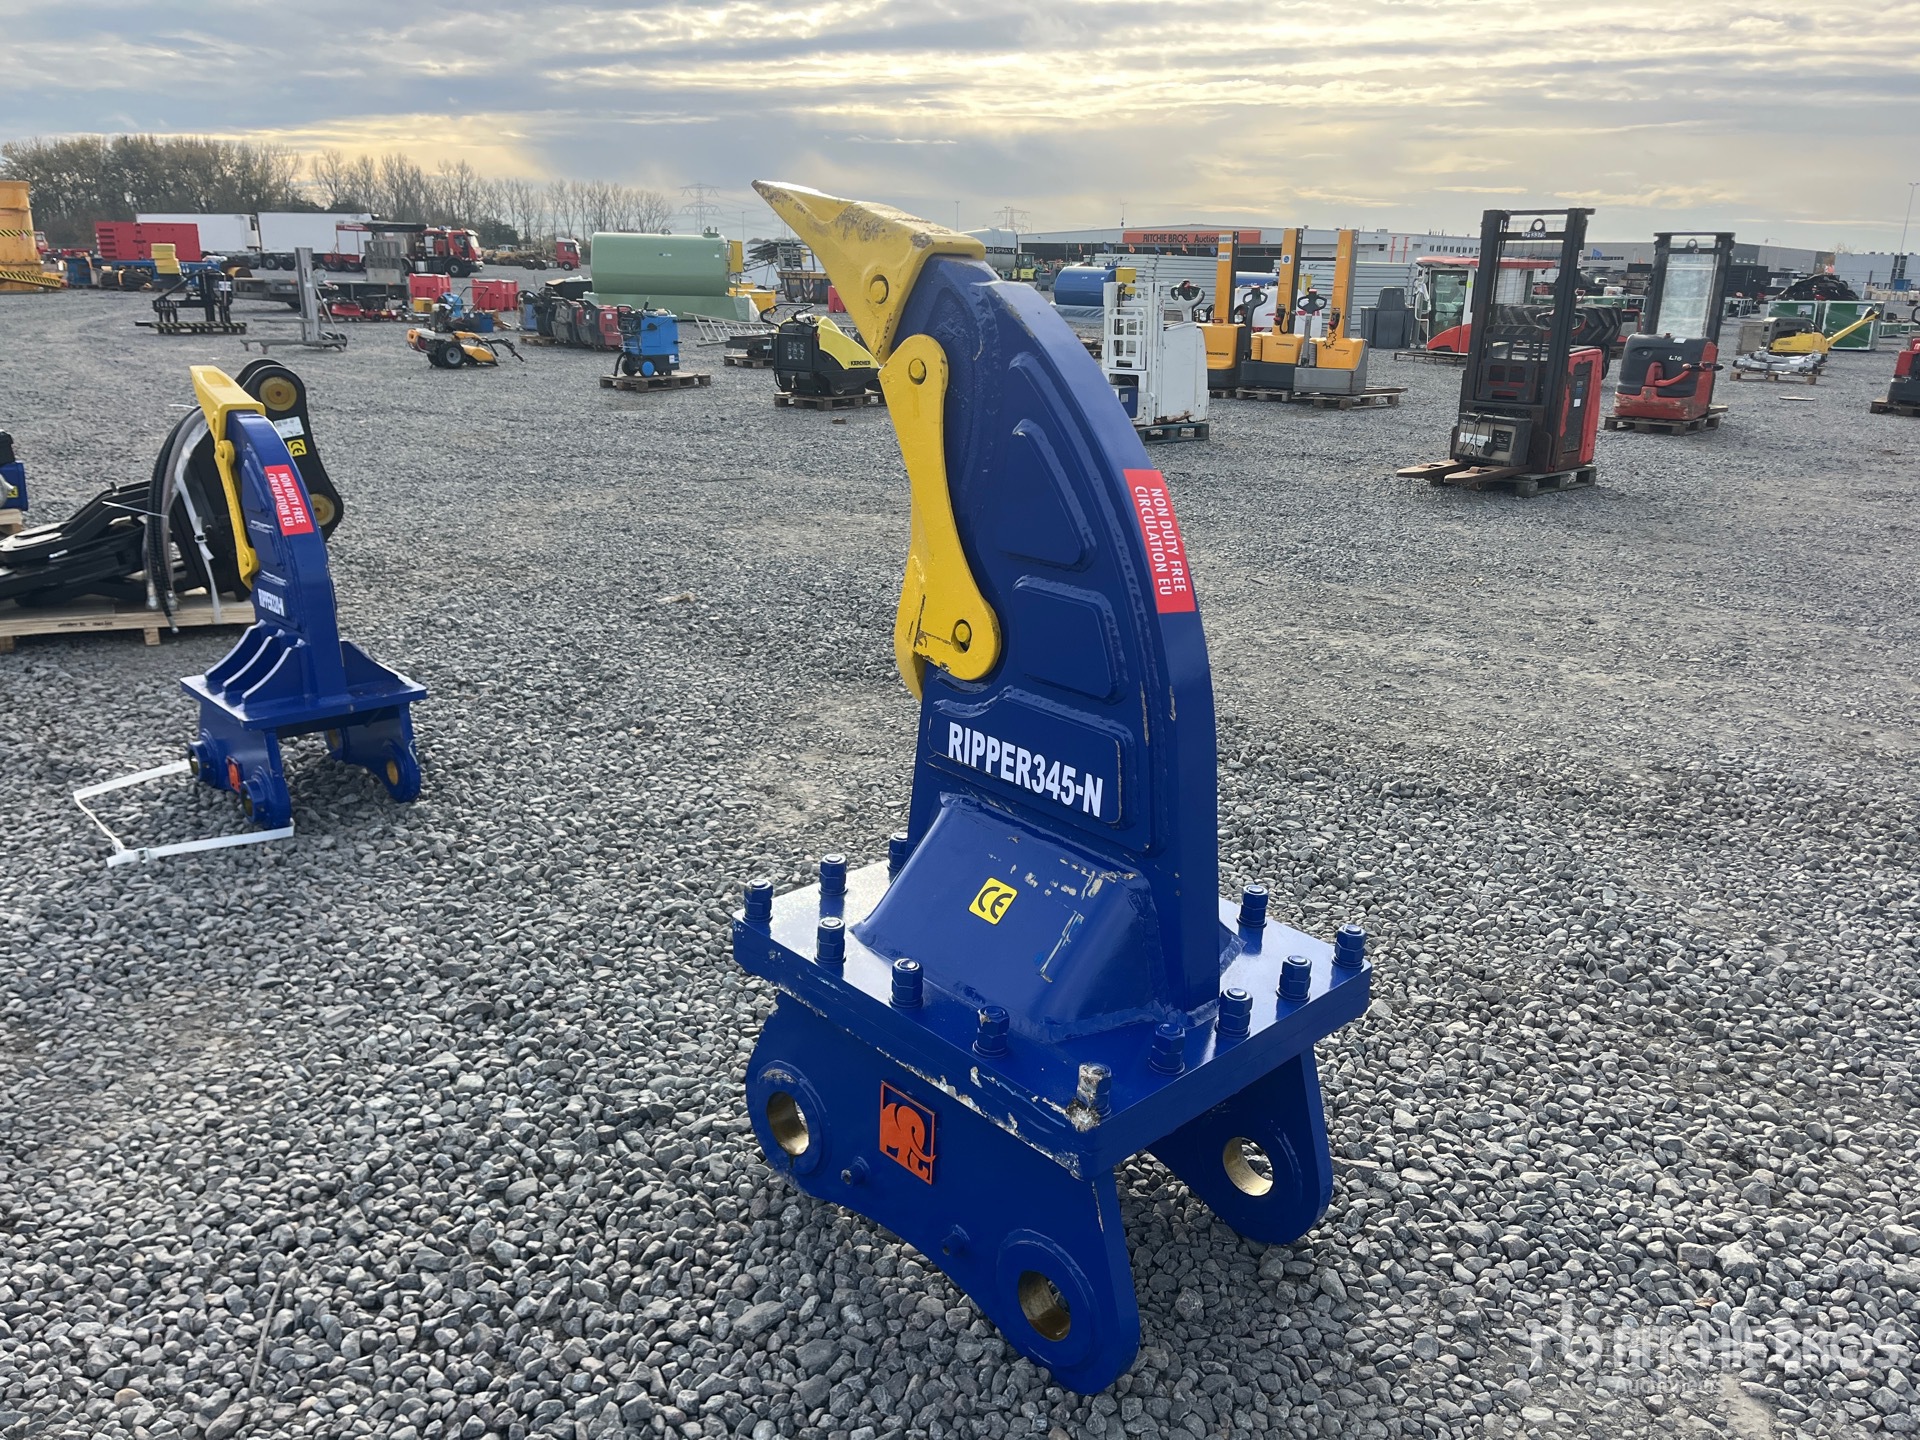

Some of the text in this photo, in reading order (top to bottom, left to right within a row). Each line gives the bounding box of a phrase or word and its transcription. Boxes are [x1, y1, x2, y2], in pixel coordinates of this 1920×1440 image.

[1142, 234, 1166, 243] RITCHIE
[267, 473, 295, 528] CIRCULATION EU
[277, 473, 307, 524] NON DUTY FREE
[1134, 486, 1173, 596] CIRCULATION EU
[1150, 487, 1187, 593] NON DUTY FREE
[947, 720, 1104, 818] RIPPER345-N
